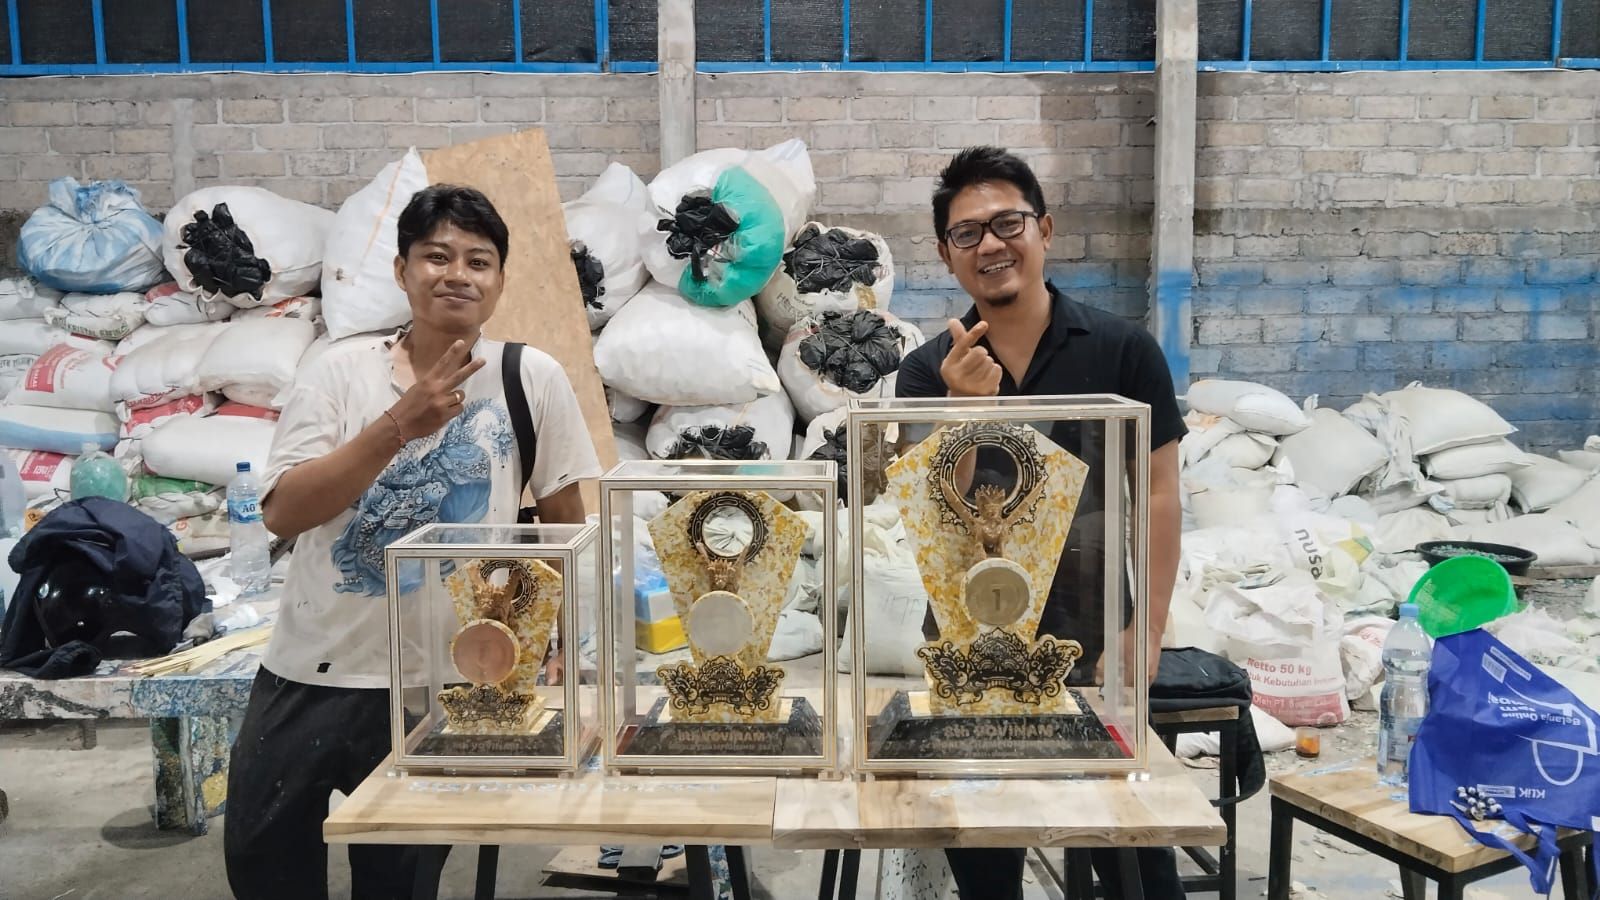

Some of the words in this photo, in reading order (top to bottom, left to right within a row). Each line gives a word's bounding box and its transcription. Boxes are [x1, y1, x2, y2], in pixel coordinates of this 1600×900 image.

[992, 587, 1001, 611] 1
[1246, 657, 1277, 673] Netto
[1280, 663, 1295, 674] 50
[1298, 664, 1313, 676] kg
[1264, 676, 1313, 687] Kebutuhan
[1253, 695, 1272, 706] Oleh
[1501, 711, 1538, 721] Online
[1540, 713, 1581, 726] Belanja
